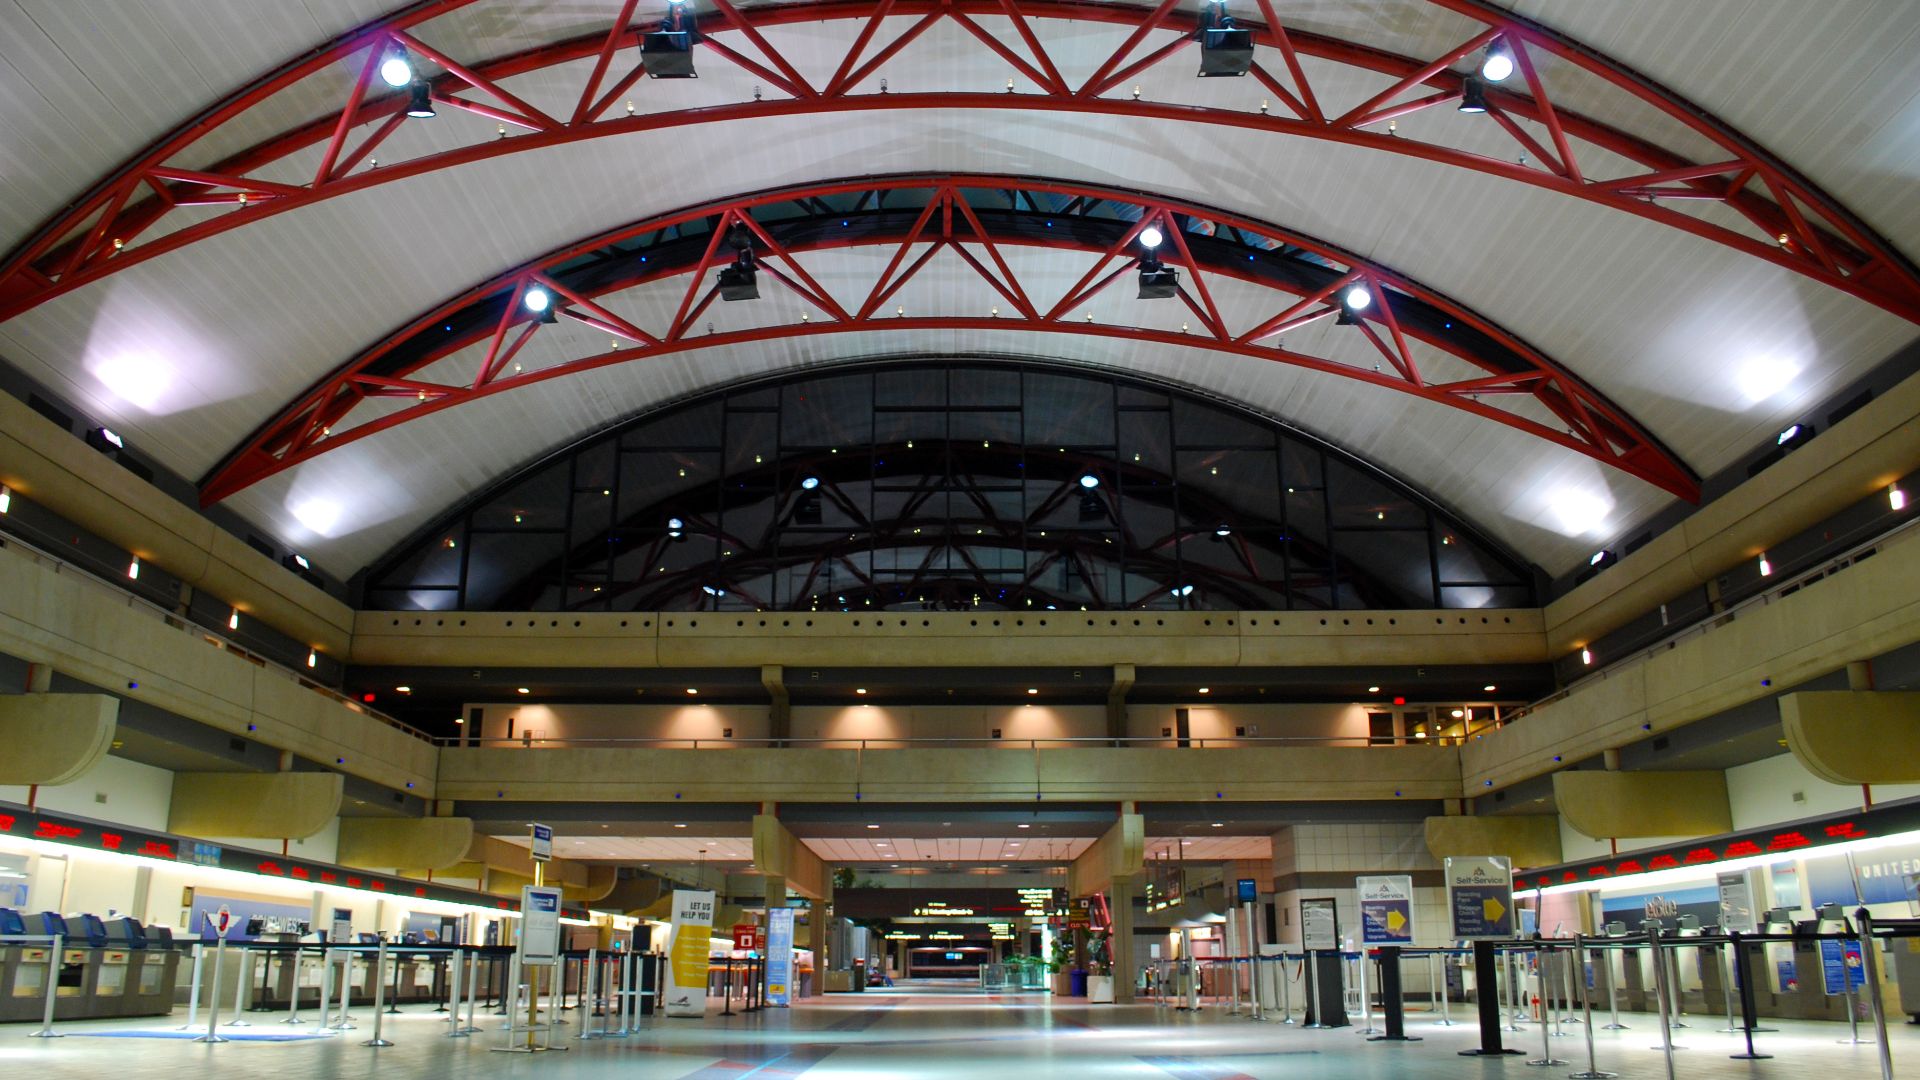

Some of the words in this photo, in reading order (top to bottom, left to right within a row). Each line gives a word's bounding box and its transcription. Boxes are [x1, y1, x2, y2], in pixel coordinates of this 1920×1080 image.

[1862, 859, 1920, 879] UNITED
[690, 902, 701, 911] LET
[702, 903, 711, 911] US
[681, 911, 696, 919] HELP
[697, 911, 710, 920] YOU
